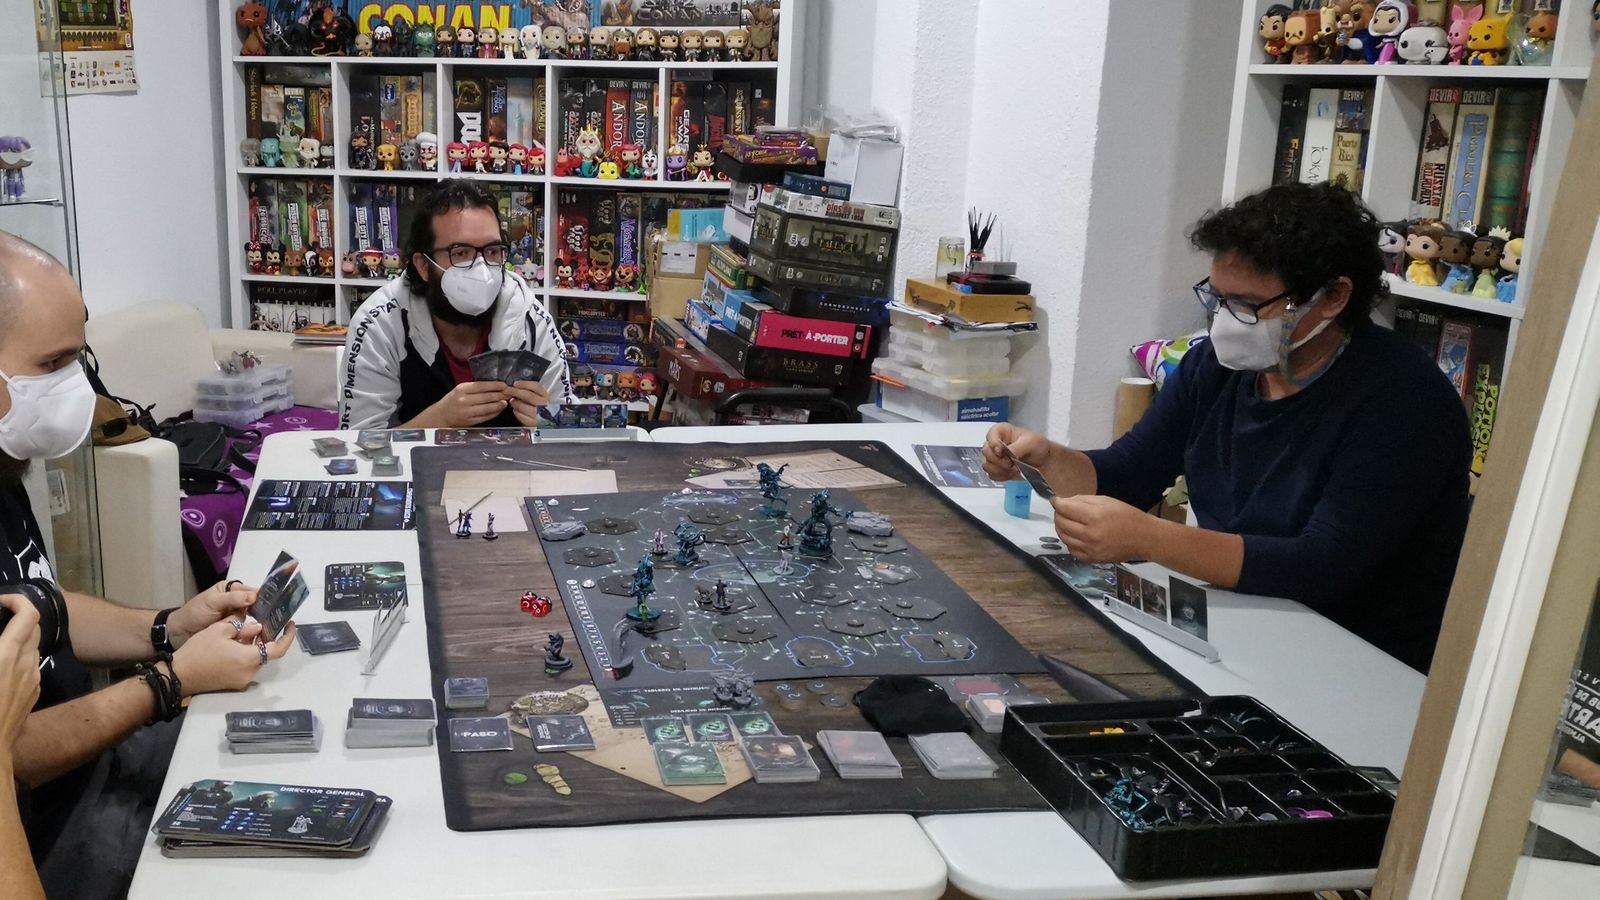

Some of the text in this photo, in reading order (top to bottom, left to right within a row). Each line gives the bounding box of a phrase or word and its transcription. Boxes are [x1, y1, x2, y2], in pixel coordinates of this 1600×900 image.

[358, 3, 512, 34] CONAN
[609, 80, 625, 88] DEVIR
[1429, 89, 1453, 102] DEVIR
[1462, 90, 1486, 103] DEVIR
[568, 111, 576, 156] GALACTIC
[611, 100, 626, 150] ANDOR
[633, 100, 648, 149] ANDOR
[1337, 135, 1357, 148] Puerto
[1338, 149, 1354, 161] Rico
[1463, 121, 1484, 189] PRIMERA
[1430, 163, 1445, 207] RUSSIAN
[344, 317, 373, 400] DIMENSION
[783, 358, 819, 369] BRASS
[1478, 385, 1498, 457] POTION
[280, 786, 365, 797] DIRECTOR GENERAL
